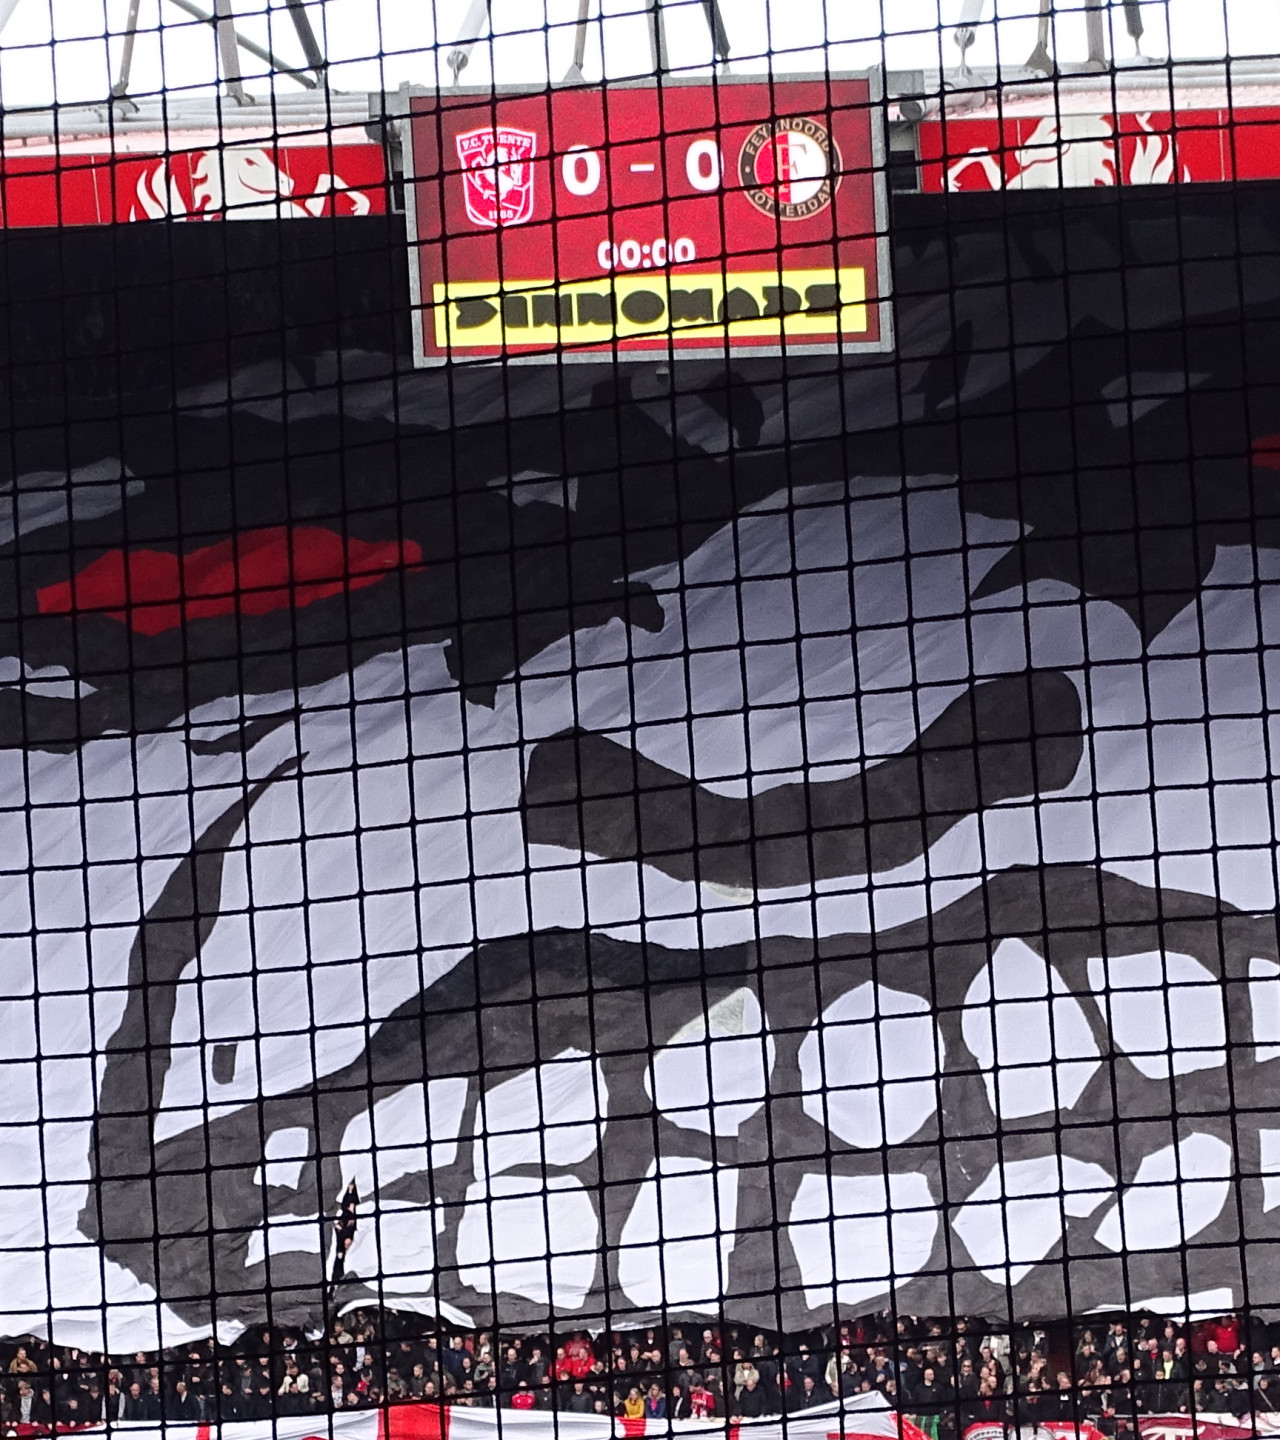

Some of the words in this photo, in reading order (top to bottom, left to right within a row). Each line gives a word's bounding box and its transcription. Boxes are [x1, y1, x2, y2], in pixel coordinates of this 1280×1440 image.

[746, 118, 830, 155] FEYNOORD
[561, 144, 601, 196] 0
[685, 139, 725, 193] 0
[597, 237, 696, 270] 00:00
